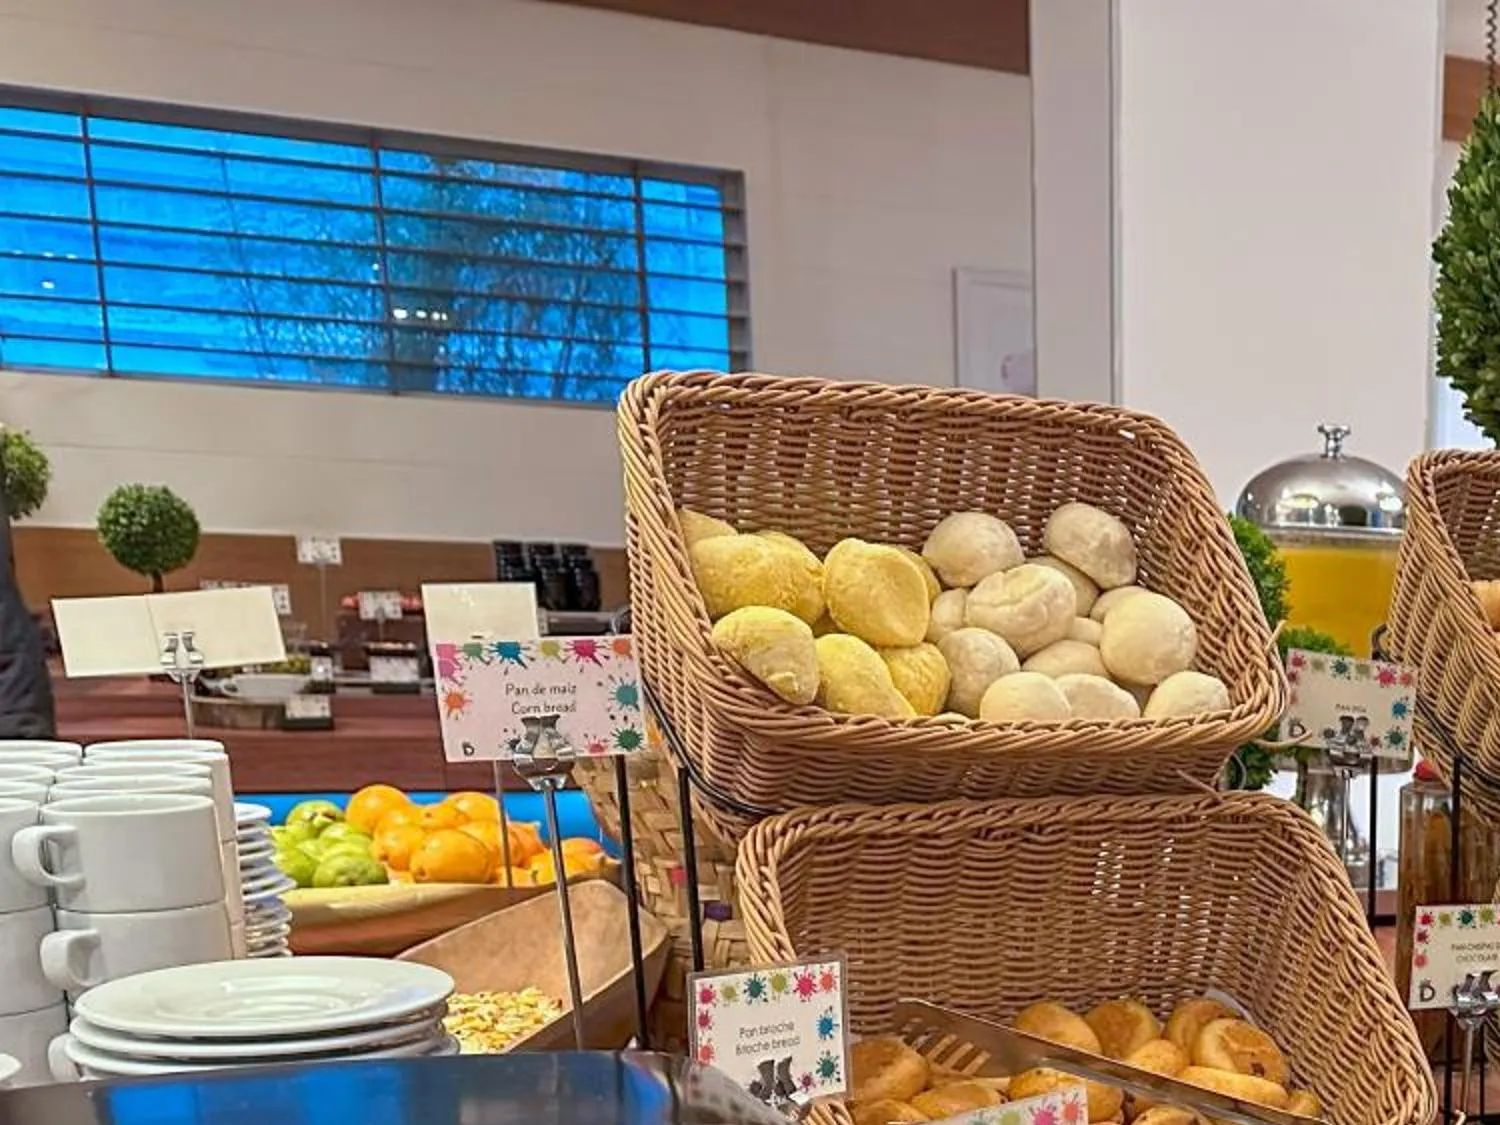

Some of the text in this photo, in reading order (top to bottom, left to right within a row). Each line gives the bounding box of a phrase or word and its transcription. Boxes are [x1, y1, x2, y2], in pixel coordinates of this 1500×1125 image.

[506, 683, 530, 696] Pan
[531, 681, 547, 695] de
[511, 701, 577, 714] Corn bread
